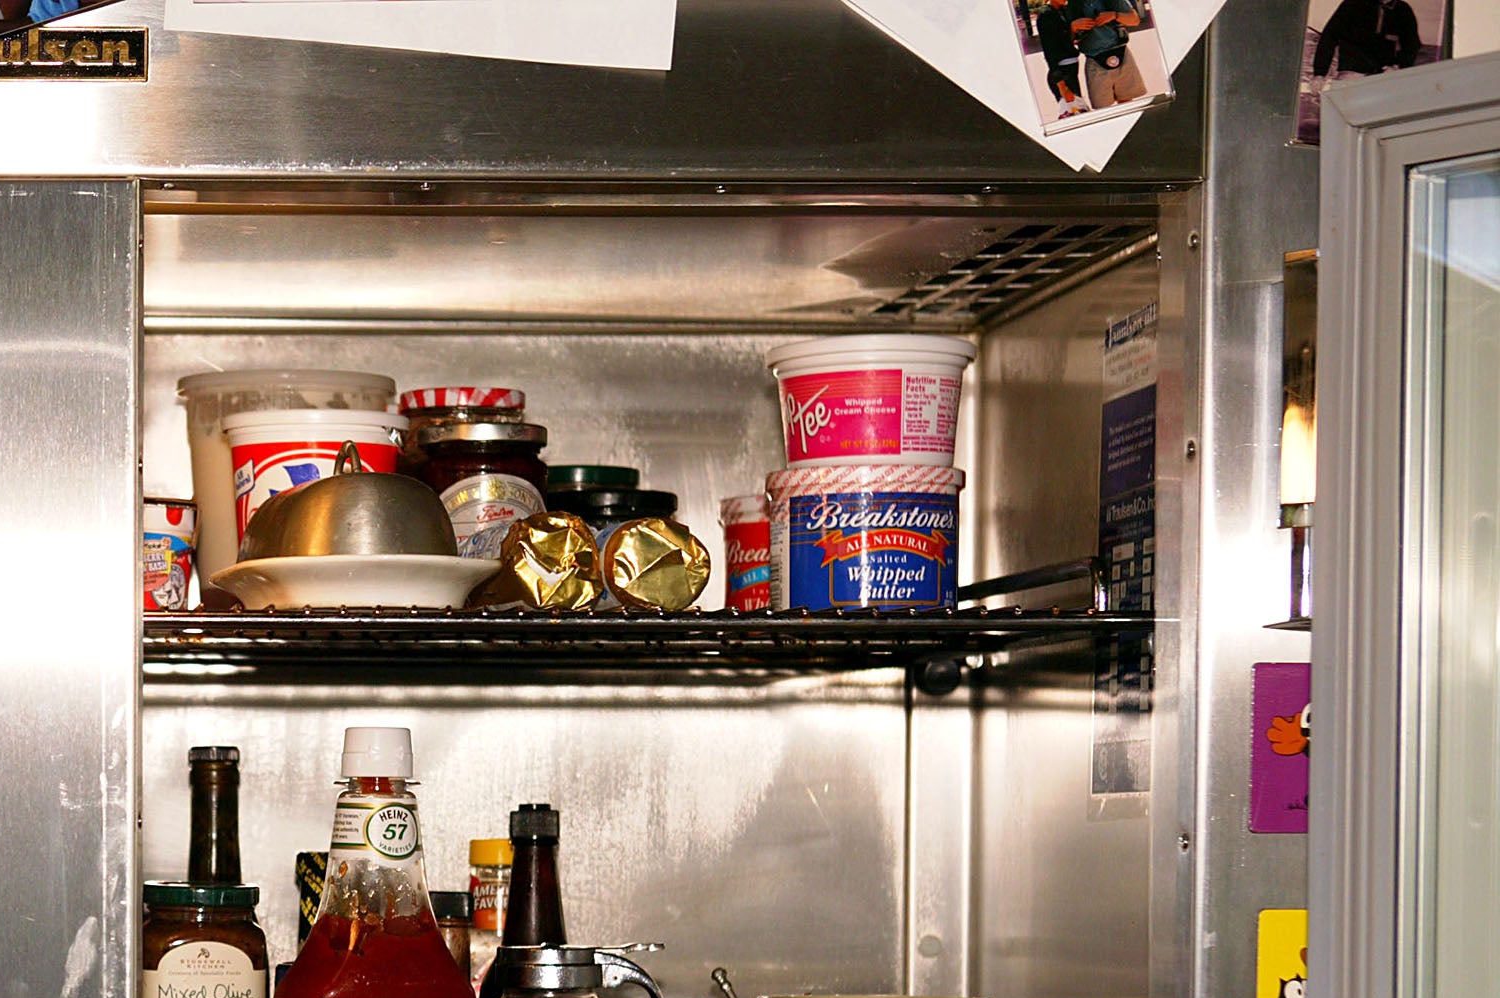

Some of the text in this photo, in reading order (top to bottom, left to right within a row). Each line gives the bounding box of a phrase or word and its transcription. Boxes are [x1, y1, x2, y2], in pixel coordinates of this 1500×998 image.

[906, 376, 937, 385] Nutrition
[906, 384, 926, 393] Facts
[844, 398, 883, 408] Whipped
[834, 406, 896, 416] Cream Cheese
[846, 534, 928, 553] ALL NATURAL
[869, 554, 907, 563] Salted
[848, 566, 926, 585] Whipped
[858, 584, 915, 599] Butter
[379, 809, 409, 822] HEINZ
[382, 823, 408, 841] 57
